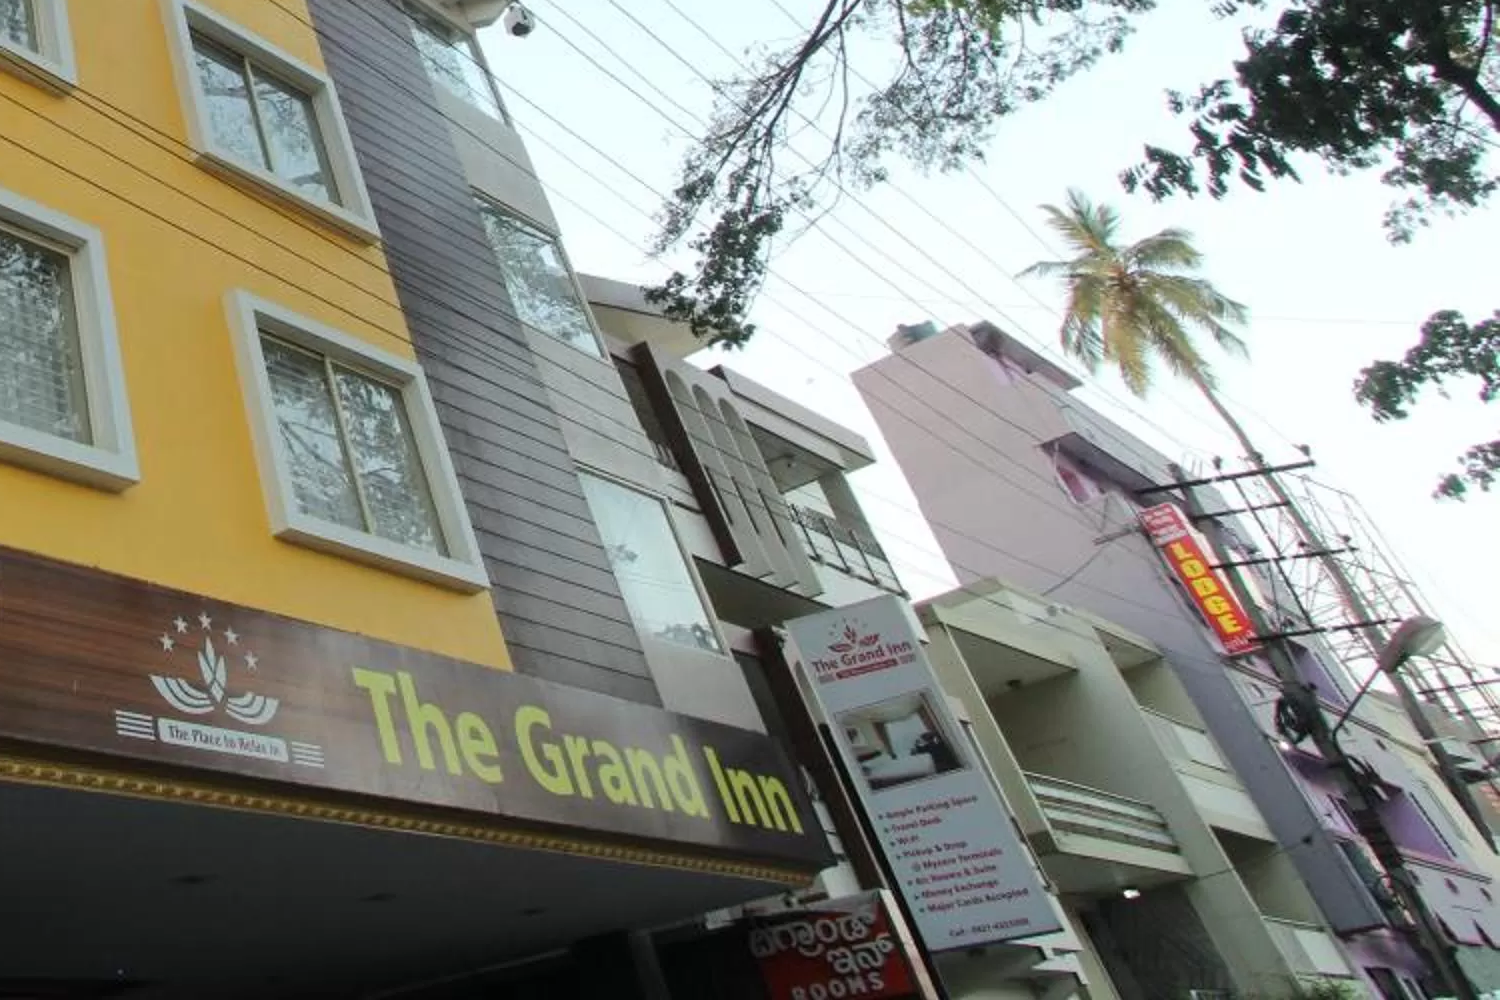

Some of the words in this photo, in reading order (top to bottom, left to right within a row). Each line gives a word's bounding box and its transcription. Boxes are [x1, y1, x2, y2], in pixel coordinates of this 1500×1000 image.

[1170, 541, 1243, 634] LODGE
[811, 659, 839, 673] The
[841, 644, 885, 666] Grand
[168, 725, 189, 741] The
[191, 729, 222, 747] Place
[352, 667, 503, 784] The
[515, 706, 711, 820] Grand
[703, 745, 804, 834] Inn
[792, 971, 886, 1000] ROOMS
